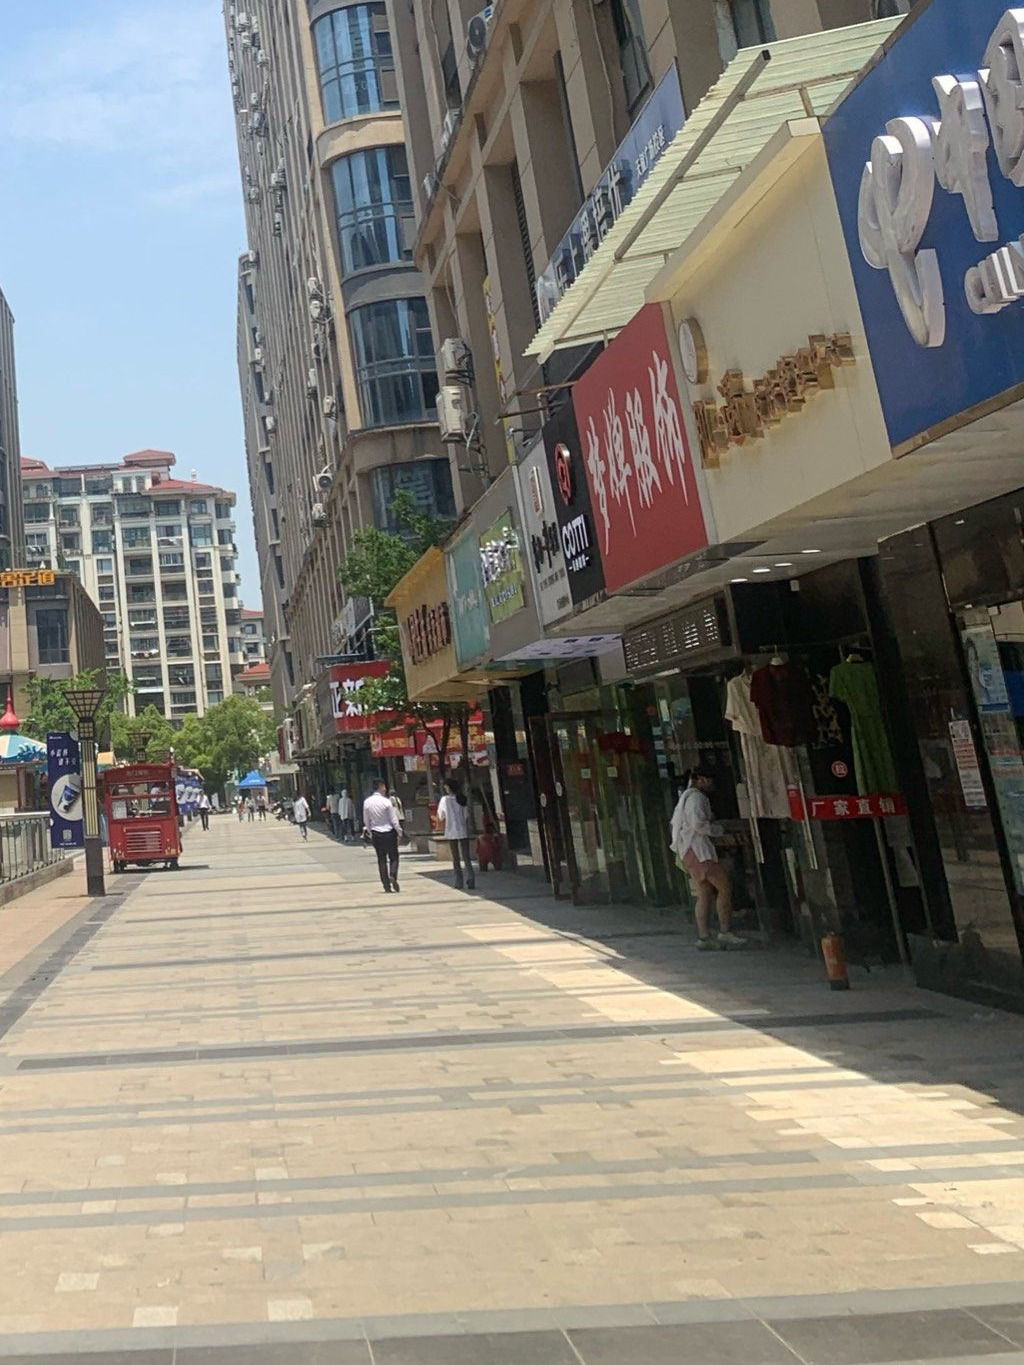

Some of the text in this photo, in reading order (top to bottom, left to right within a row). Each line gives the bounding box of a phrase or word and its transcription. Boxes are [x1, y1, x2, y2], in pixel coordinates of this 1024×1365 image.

[562, 514, 588, 559] COTTI
[812, 797, 896, 817] 厂家直销
